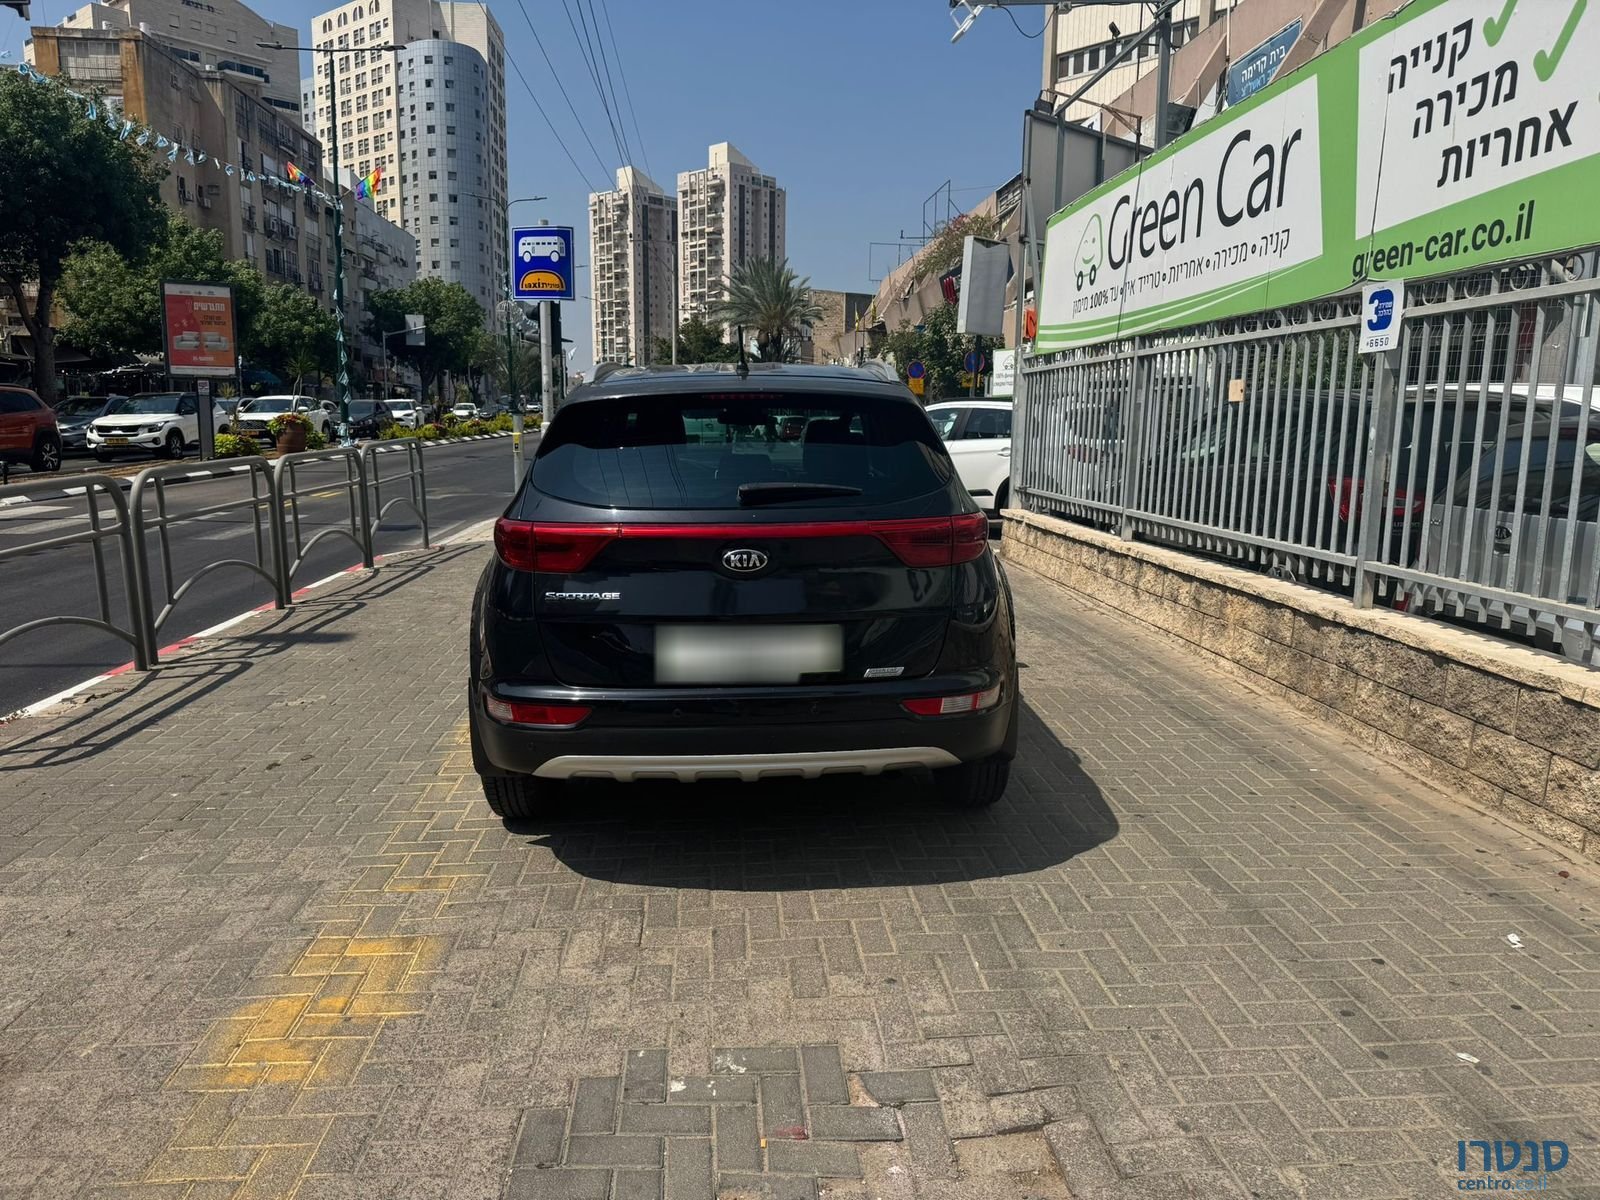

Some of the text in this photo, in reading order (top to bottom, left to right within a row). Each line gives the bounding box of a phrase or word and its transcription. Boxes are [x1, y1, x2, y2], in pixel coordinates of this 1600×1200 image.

[1241, 45, 1285, 82] בית קדימה
[1387, 18, 1474, 95] קנייה
[1412, 60, 1519, 139] מכירה
[1436, 100, 1579, 188] אחריות
[1108, 128, 1302, 270] Green Car
[1213, 241, 1248, 271] מכירה
[1259, 228, 1291, 258] קניה
[1352, 200, 1535, 283] green-car.co.il
[1138, 270, 1160, 293] טרייד
[1168, 256, 1205, 285] אחריות
[1072, 296, 1089, 319] מימון
[1090, 289, 1109, 308] 100%
[730, 554, 761, 567] KIA
[545, 591, 621, 600] SPORTAGE
